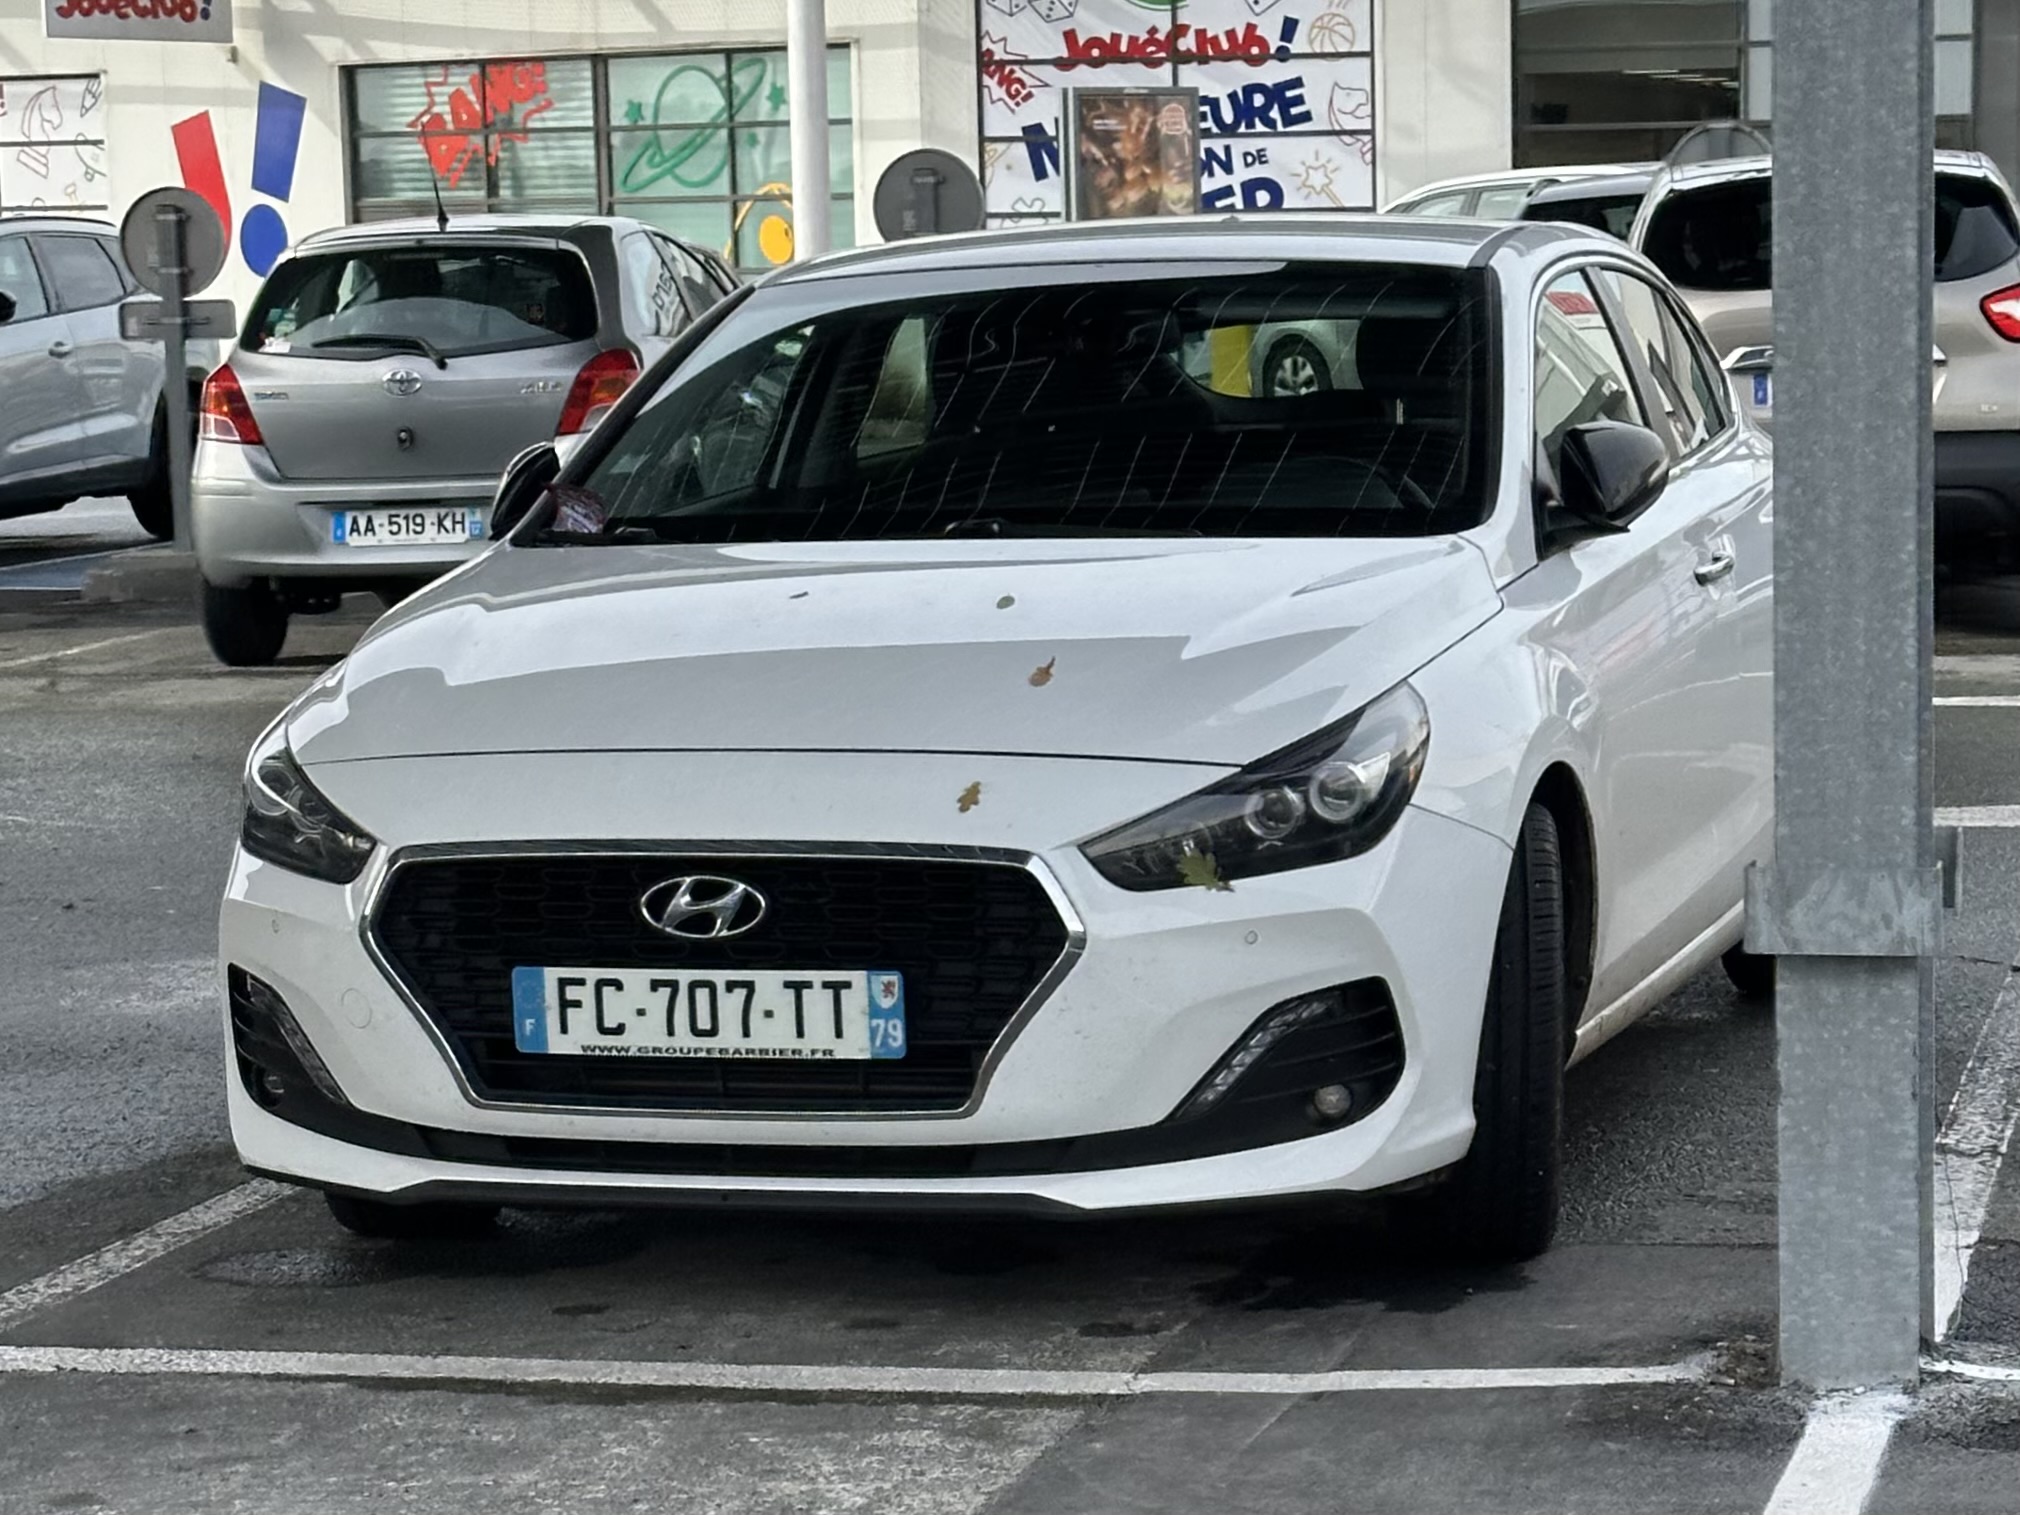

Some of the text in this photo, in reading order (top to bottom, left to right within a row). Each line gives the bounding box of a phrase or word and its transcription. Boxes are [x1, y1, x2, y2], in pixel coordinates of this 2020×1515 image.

[349, 511, 466, 537] AA-519-KH
[525, 1018, 536, 1036] F
[871, 1018, 903, 1047] 79
